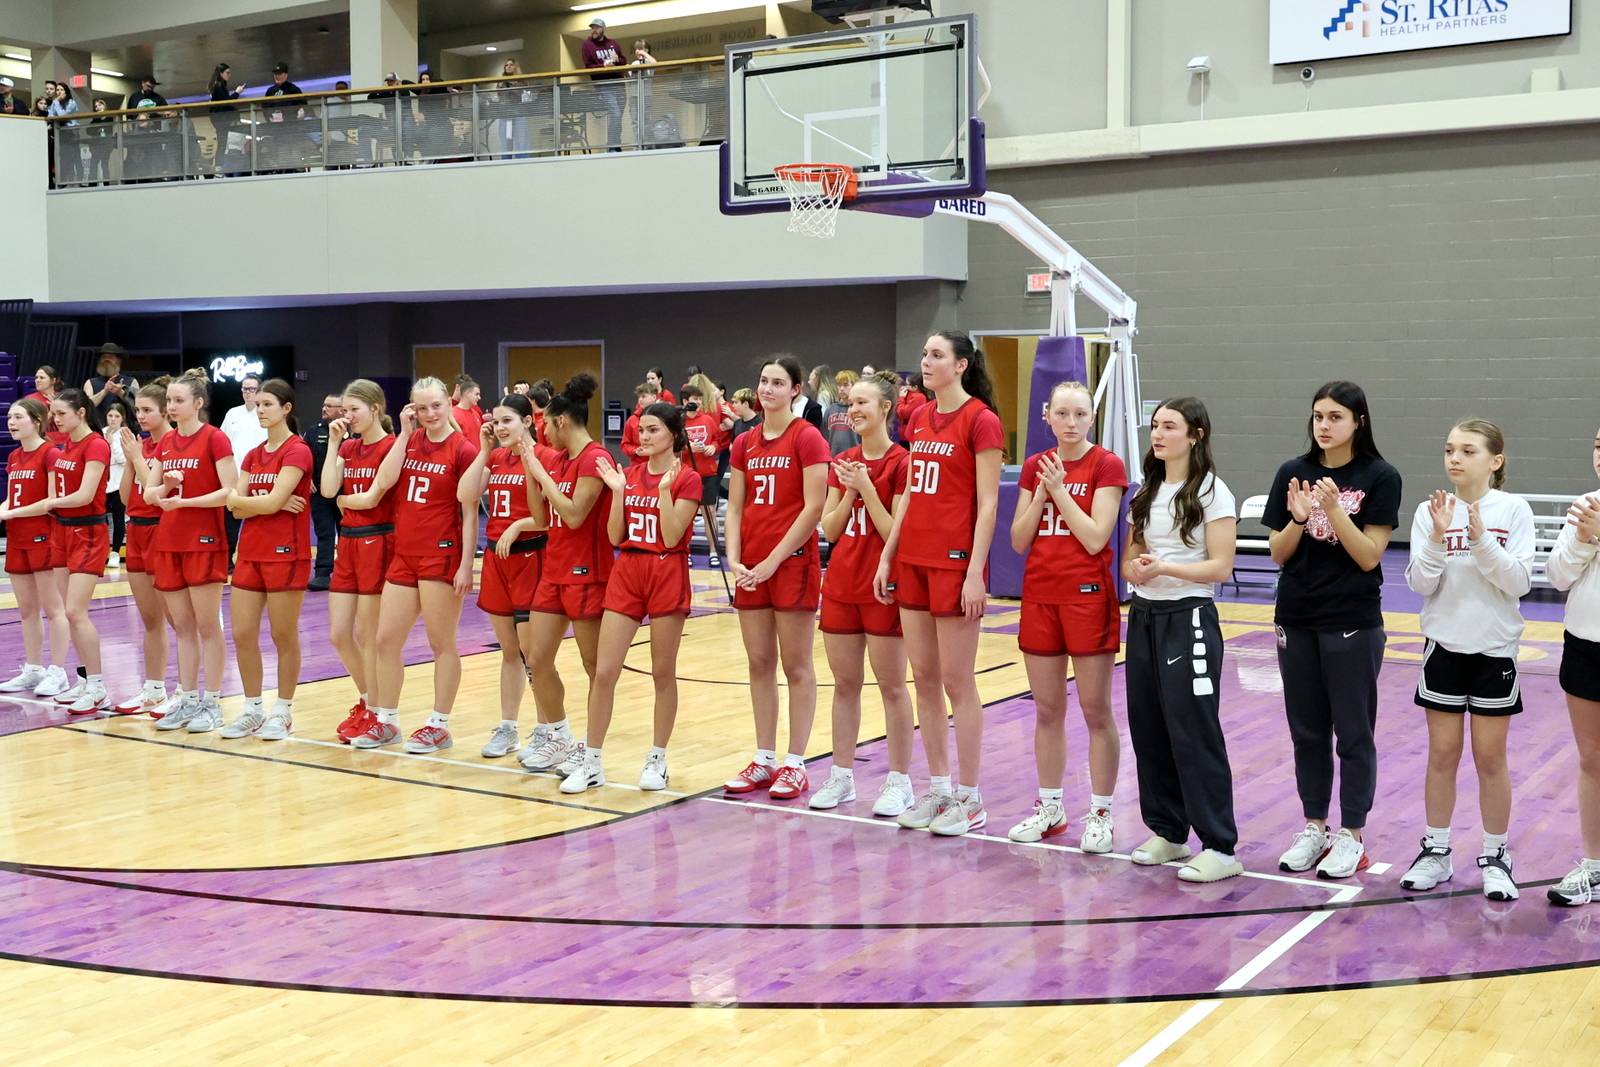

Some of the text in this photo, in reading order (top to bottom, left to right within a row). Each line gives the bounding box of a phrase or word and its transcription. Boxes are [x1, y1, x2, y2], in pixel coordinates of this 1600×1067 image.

[719, 27, 757, 44] ROOM
[1380, 14, 1507, 36] HEALTH PARTNERS
[939, 199, 986, 217] GARED
[406, 475, 431, 504] 12
[753, 474, 776, 505] 21
[911, 459, 940, 495] 30
[13, 483, 22, 506] 2
[492, 489, 511, 518] 13
[628, 512, 658, 544] 20
[1430, 847, 1448, 855] NIKE
